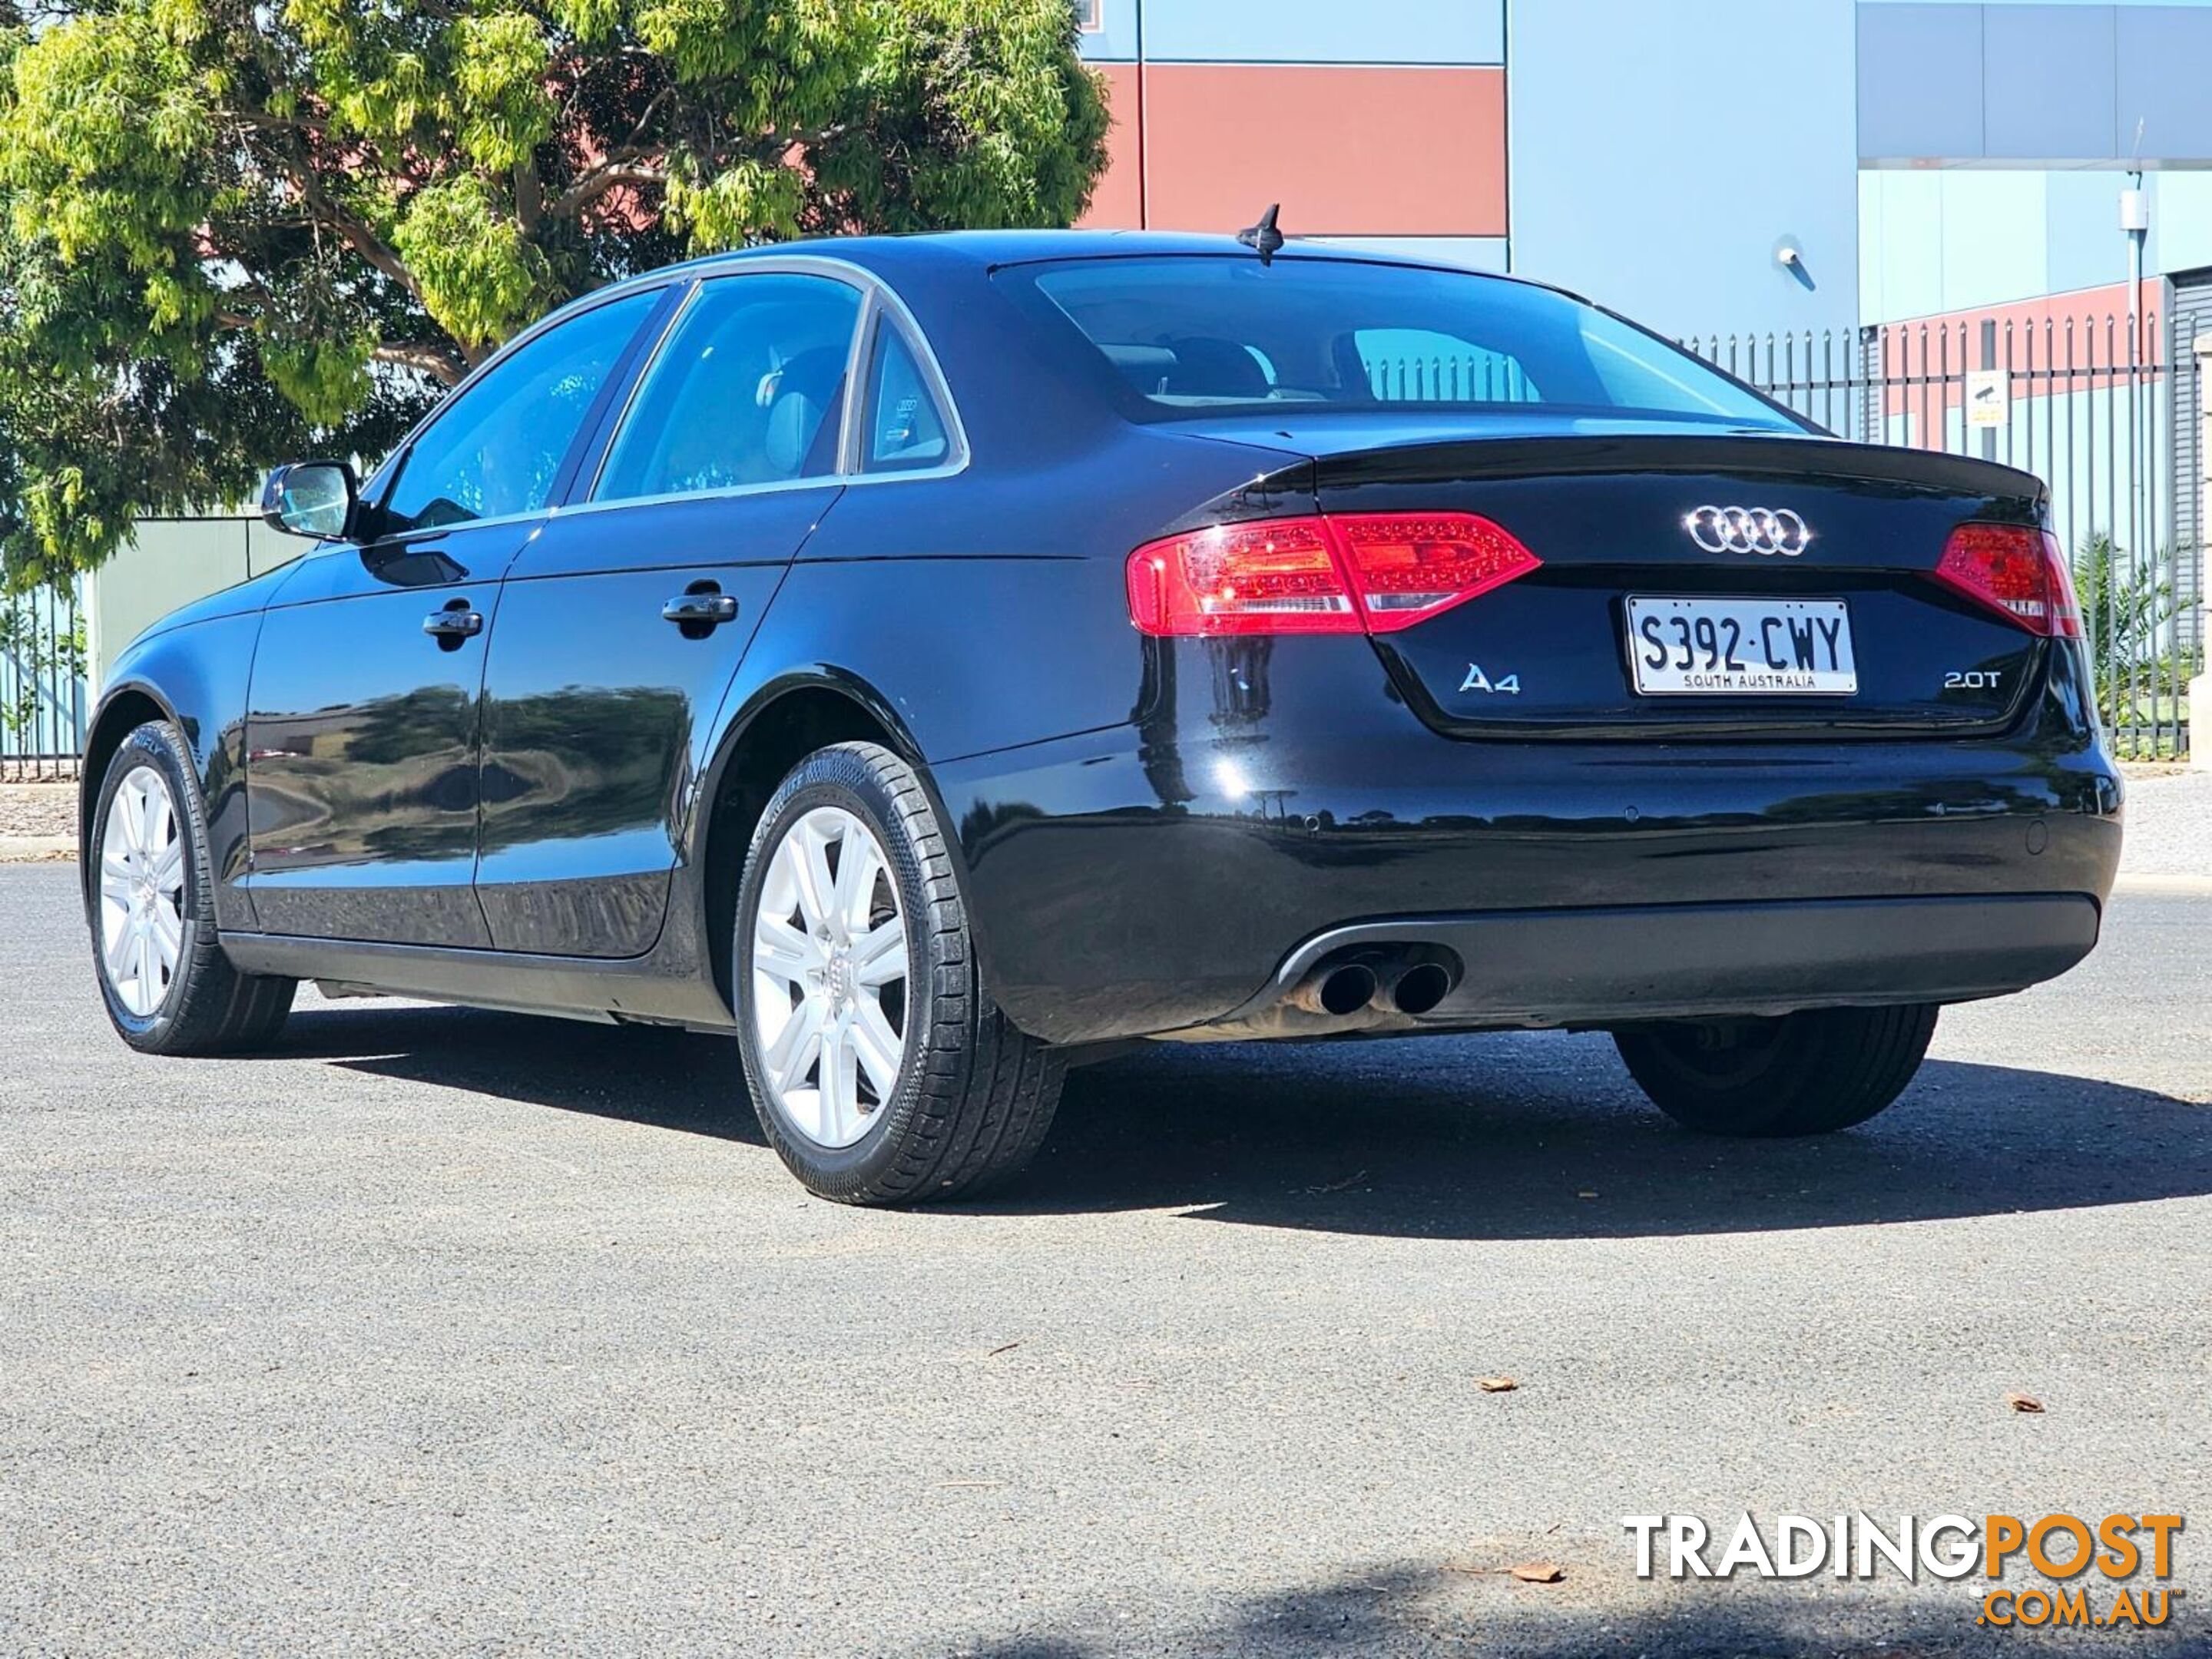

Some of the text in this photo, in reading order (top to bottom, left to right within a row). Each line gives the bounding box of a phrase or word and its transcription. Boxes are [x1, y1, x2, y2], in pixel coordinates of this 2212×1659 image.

[1459, 663, 1520, 694] A4
[1684, 675, 1815, 687] SOUTH AUSTRALIA
